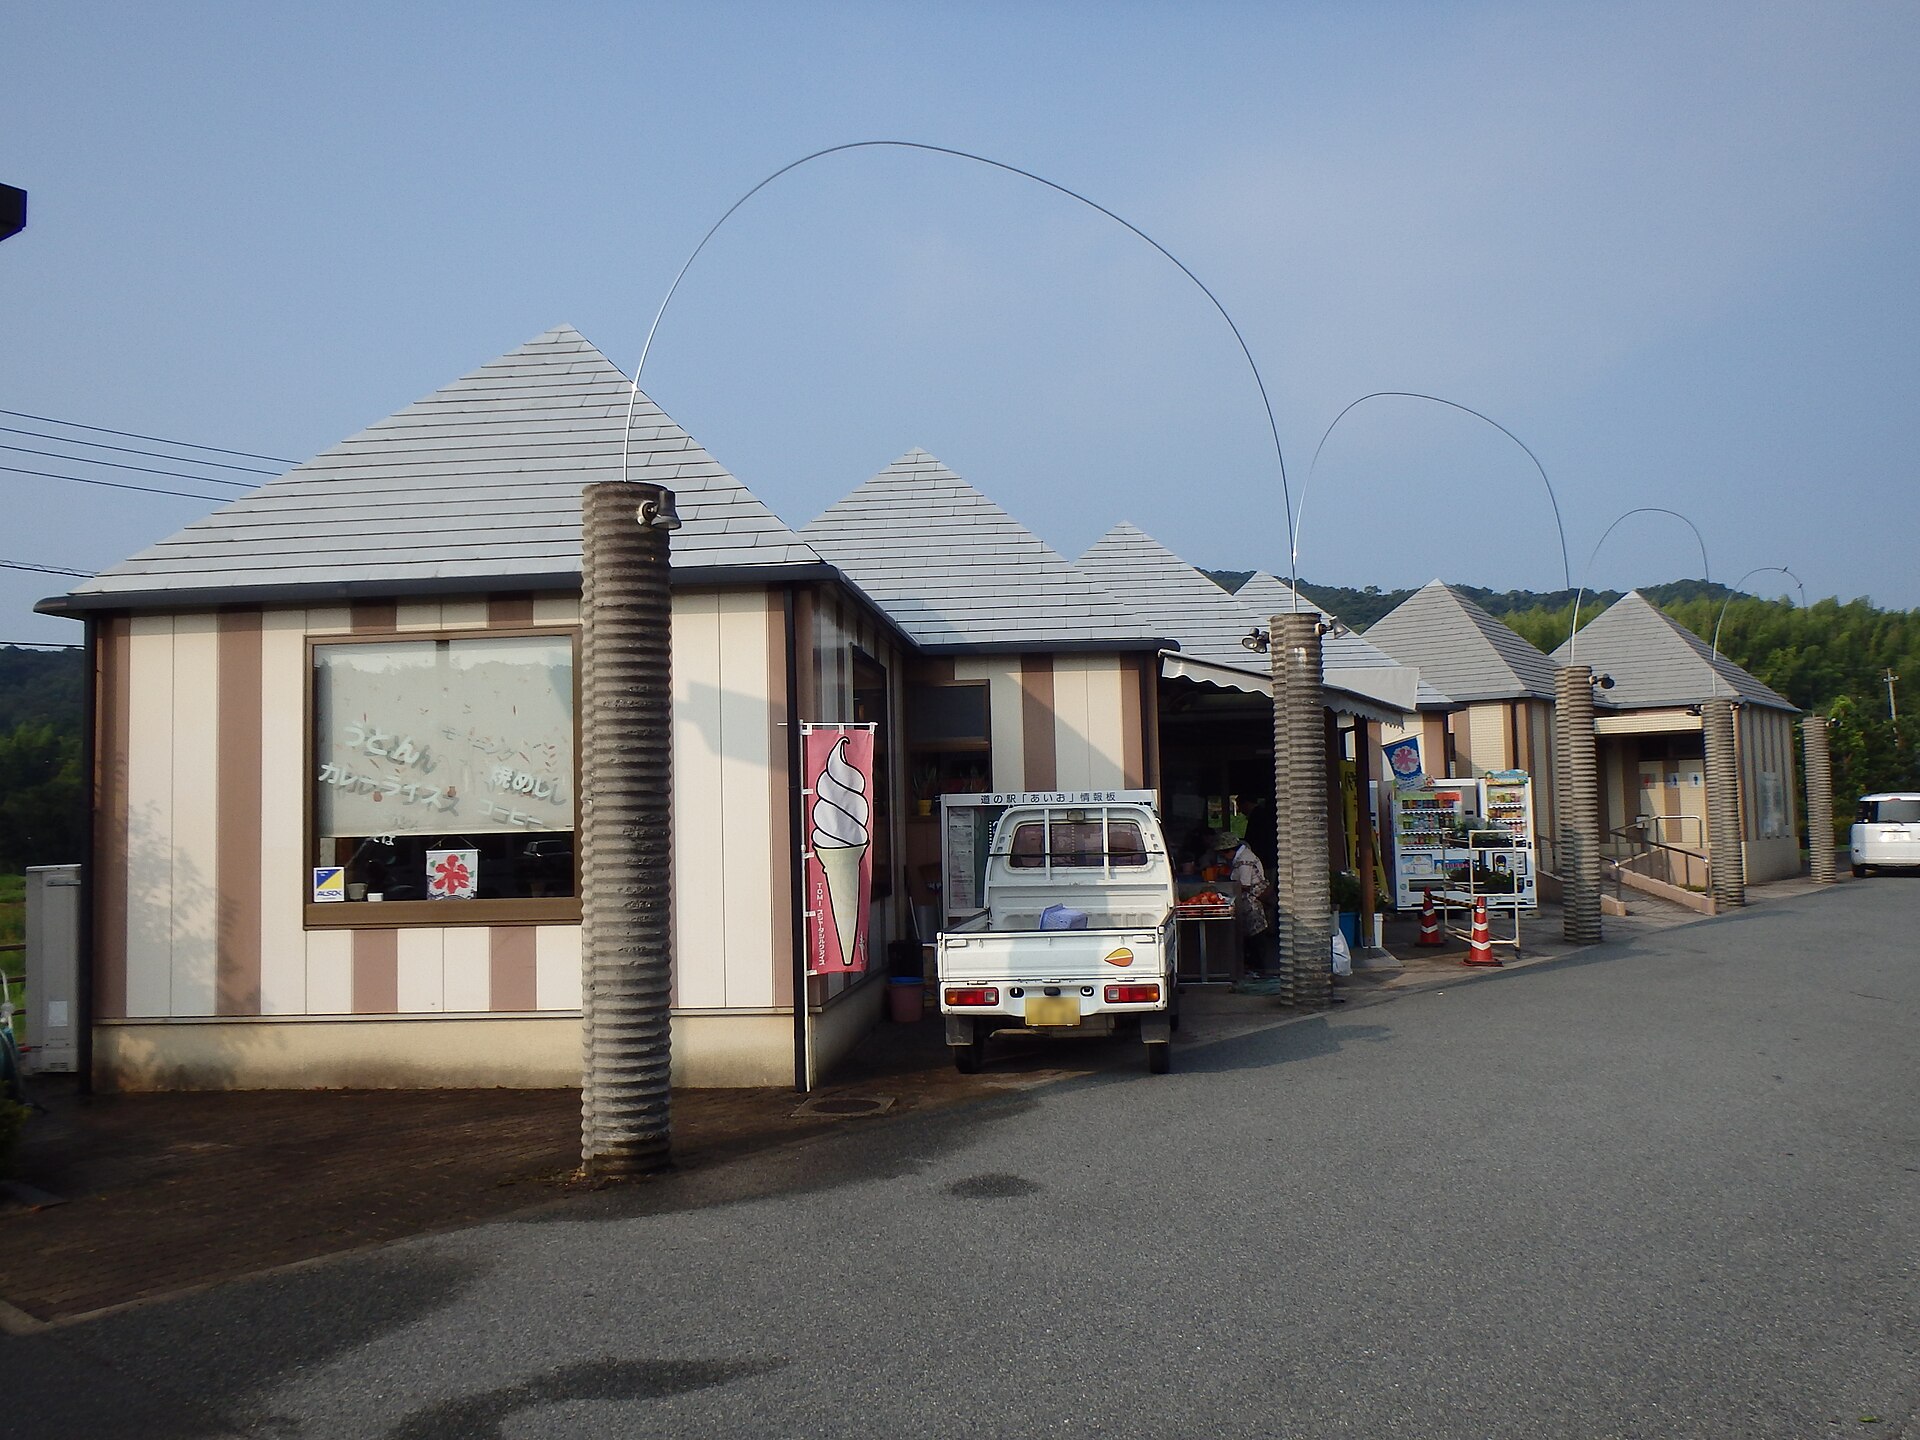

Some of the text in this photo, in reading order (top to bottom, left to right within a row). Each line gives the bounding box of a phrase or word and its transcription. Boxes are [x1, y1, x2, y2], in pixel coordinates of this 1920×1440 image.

[318, 762, 443, 809] カレーライス
[980, 792, 1116, 805] 道の駅「あいお」情報板
[478, 799, 543, 826] コーヒー
